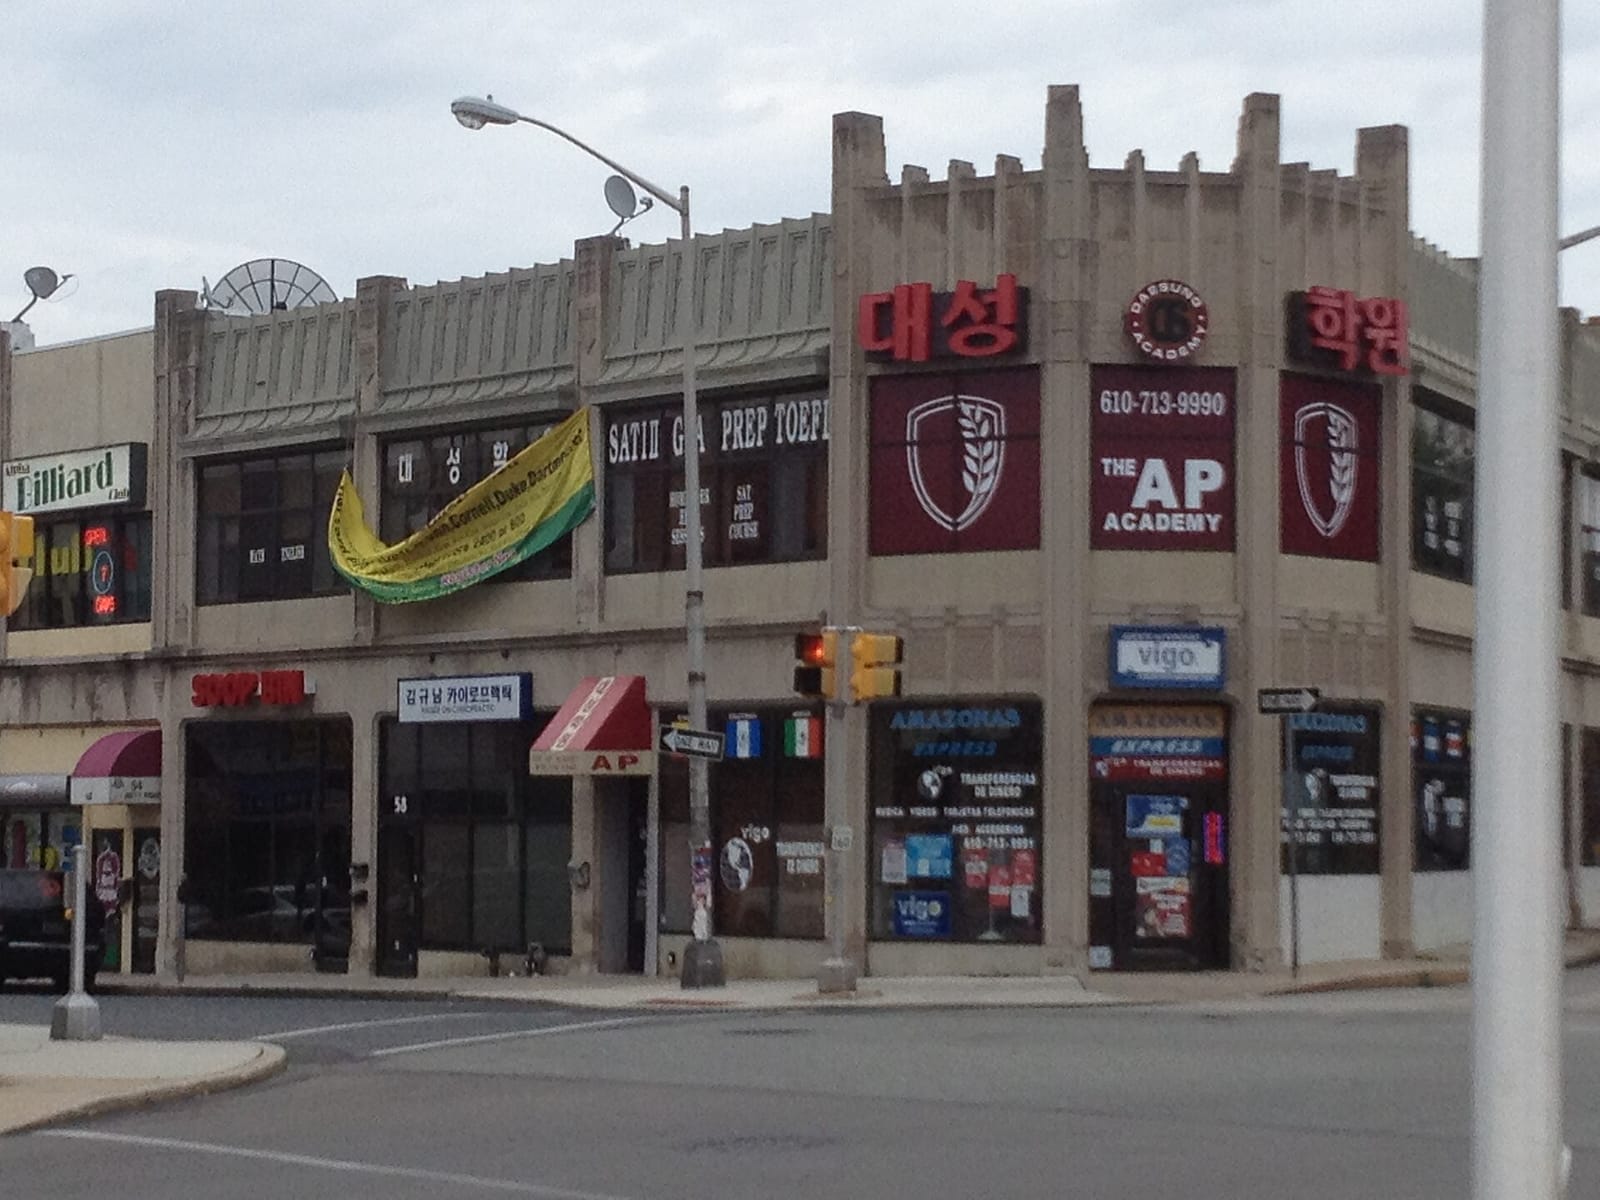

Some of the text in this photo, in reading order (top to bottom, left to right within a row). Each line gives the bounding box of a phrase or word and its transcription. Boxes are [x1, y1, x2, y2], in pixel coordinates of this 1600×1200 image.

[858, 274, 1020, 362] 대성
[1132, 325, 1206, 360] ACADEMY
[1304, 286, 1410, 376] 학원
[1101, 390, 1226, 416] 610-713-9990
[673, 414, 705, 456] GA
[721, 406, 767, 451] PREP
[17, 451, 114, 512] Billiard
[1101, 458, 1225, 510] THE AP
[1103, 512, 1223, 532] ACADEMY
[592, 754, 640, 771] AP
